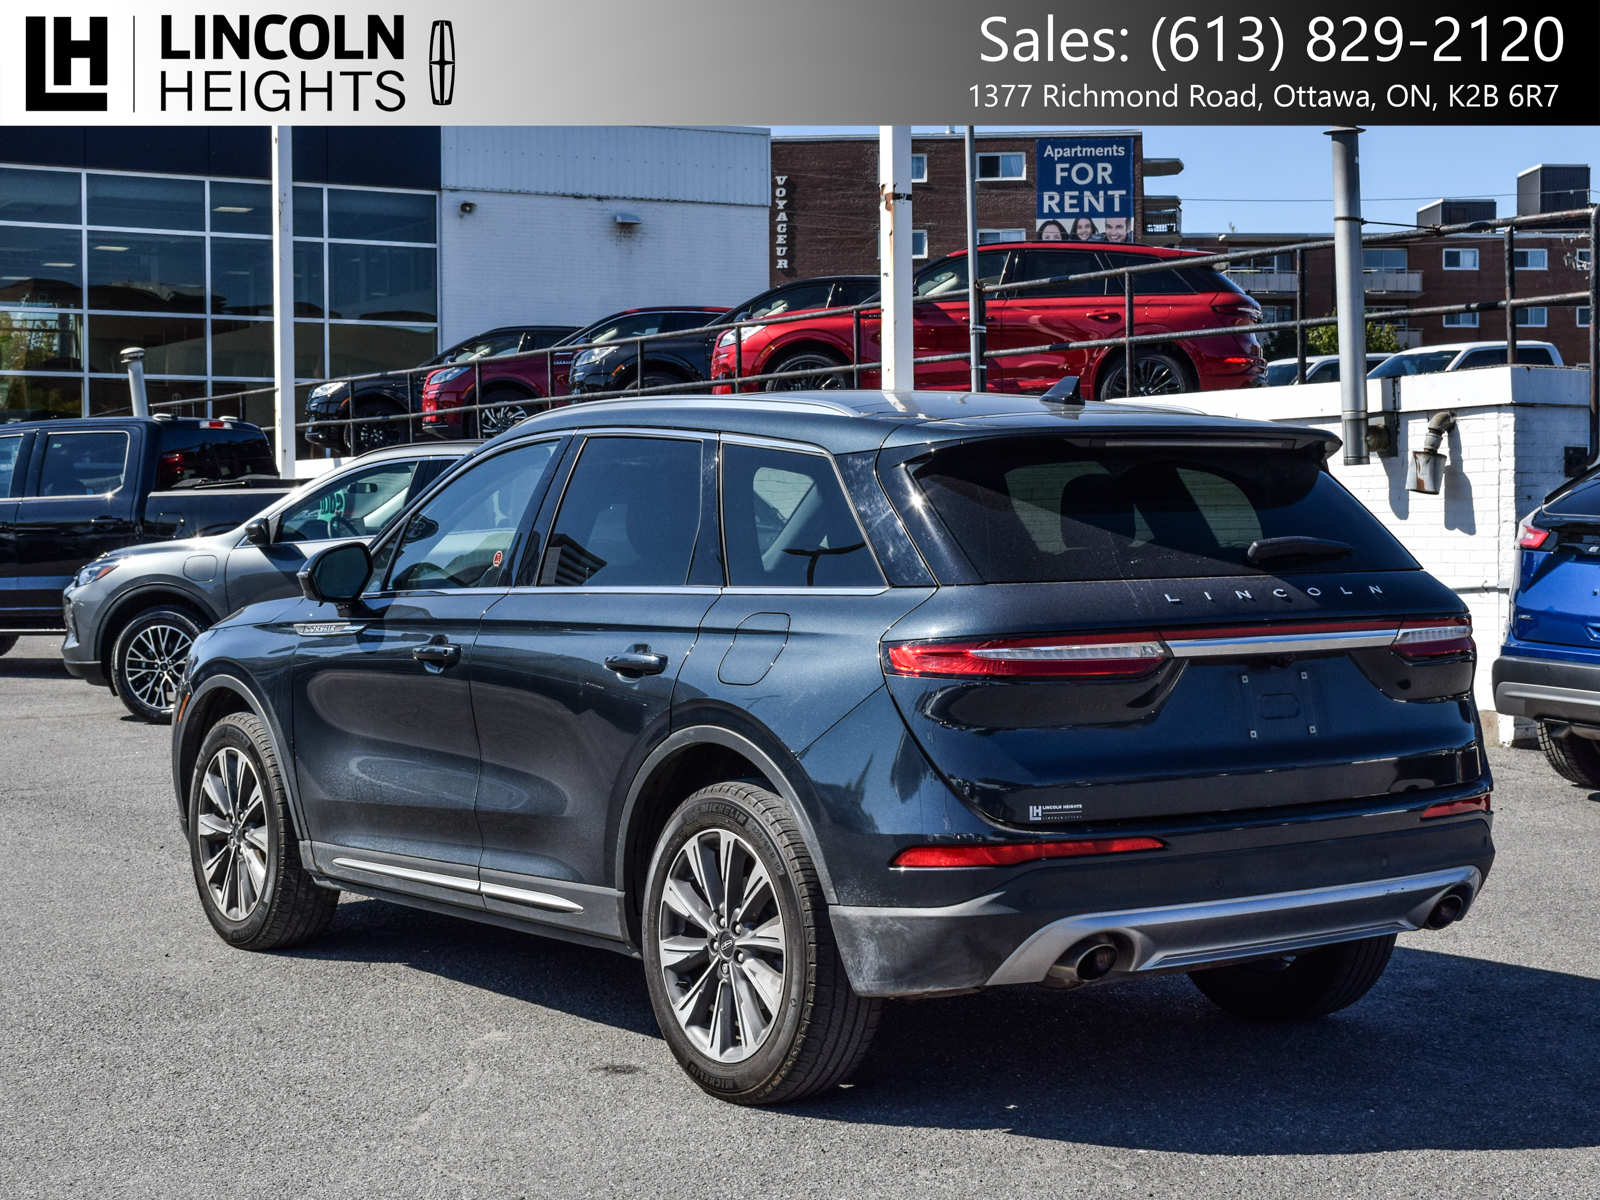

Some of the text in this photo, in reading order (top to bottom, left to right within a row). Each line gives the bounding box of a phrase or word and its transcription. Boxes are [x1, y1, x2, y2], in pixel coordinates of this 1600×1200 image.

[1043, 145, 1125, 161] Apartments
[1055, 162, 1113, 185] FOR
[1043, 190, 1127, 213] RENT
[775, 175, 789, 269] VOYAGEUR
[1164, 585, 1383, 603] LINCOLN
[701, 803, 747, 825] MICHELIN
[689, 1064, 734, 1089] MICHELIN
